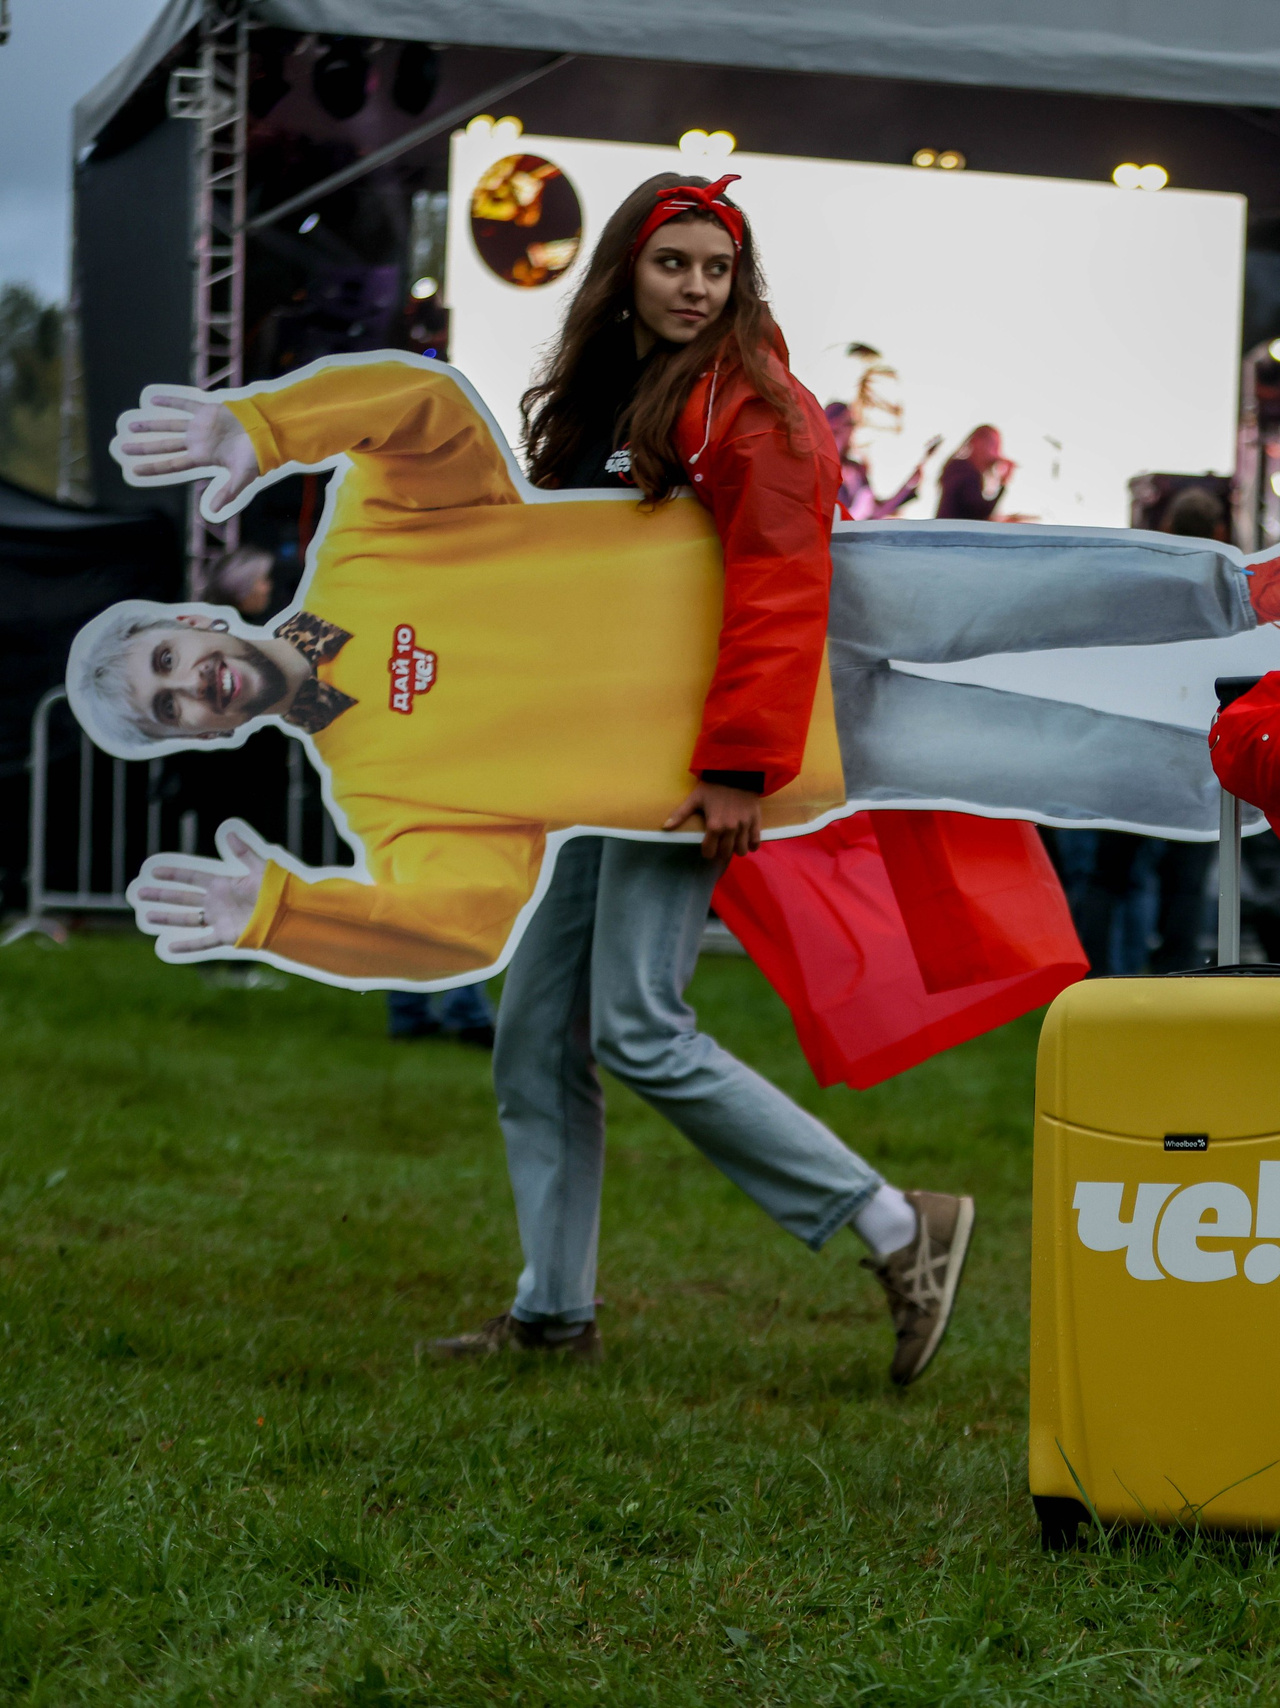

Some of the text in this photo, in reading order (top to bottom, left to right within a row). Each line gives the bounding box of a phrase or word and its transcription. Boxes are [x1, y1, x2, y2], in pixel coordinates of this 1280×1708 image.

[391, 627, 413, 712] ДАЙ 10
[1164, 1139, 1198, 1148] Wheelbee
